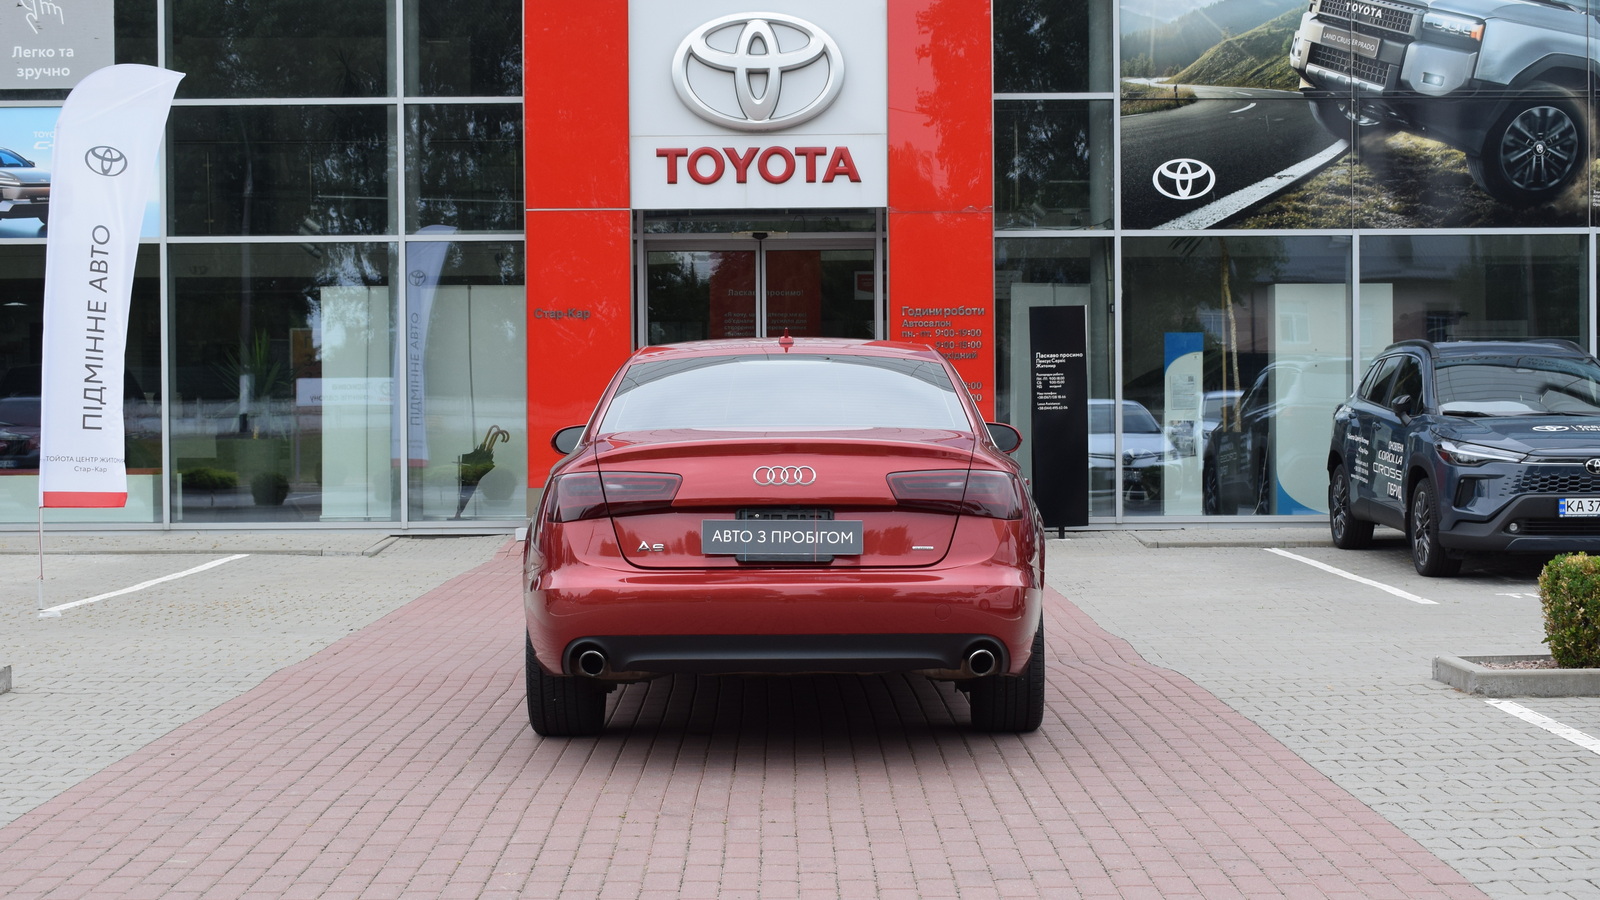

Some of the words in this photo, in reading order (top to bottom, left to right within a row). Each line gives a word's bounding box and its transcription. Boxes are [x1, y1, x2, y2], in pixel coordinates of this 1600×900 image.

[1346, 2, 1383, 19] TOYOTA
[1323, 32, 1336, 42] LAND
[1336, 35, 1358, 46] CRUISER
[1358, 40, 1375, 52] PRADO
[12, 46, 55, 59] Легко
[58, 47, 74, 58] та
[17, 66, 70, 79] зручно
[655, 145, 862, 185] TOYOTA
[88, 224, 111, 294] АВТО
[533, 308, 591, 320] Стар-Кар
[902, 306, 942, 317] Години
[944, 305, 985, 318] роботи
[410, 312, 419, 350] АВТО
[902, 319, 951, 327] Автосалон
[82, 300, 107, 431] ПІДМІННЕ
[410, 354, 422, 426] ПІДМІННЕ
[1378, 450, 1403, 466] COROLLA
[1372, 462, 1403, 481] CROSS
[1567, 501, 1584, 512] KA
[711, 530, 753, 544] АВТО
[757, 530, 766, 543] З
[771, 531, 854, 544] ПРОБІГОМ
